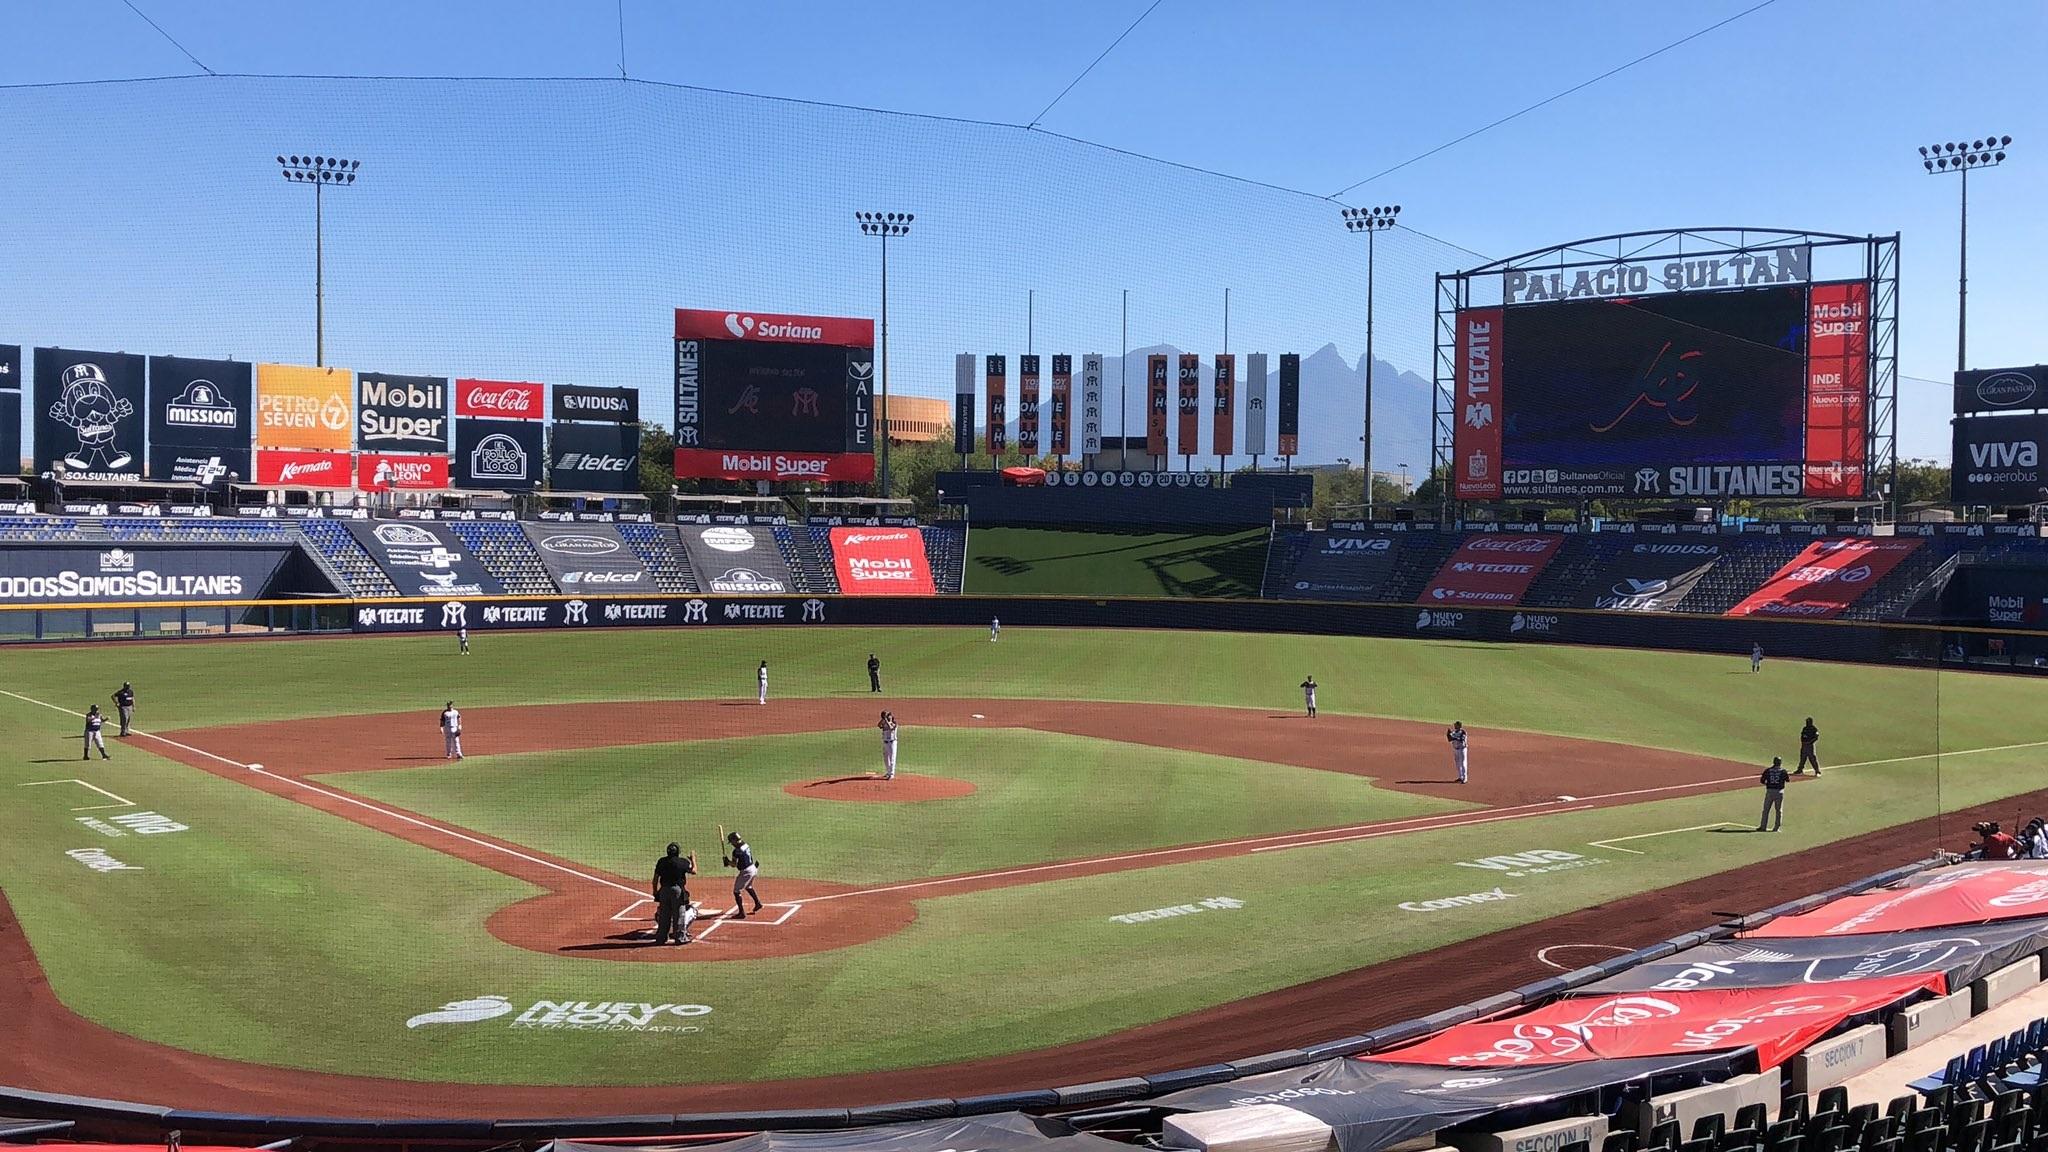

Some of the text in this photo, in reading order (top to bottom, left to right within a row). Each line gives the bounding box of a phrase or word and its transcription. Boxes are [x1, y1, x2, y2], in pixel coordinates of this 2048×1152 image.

[1504, 247, 1810, 304] PALACIO SULTAN
[1813, 303, 1862, 318] Mobil
[757, 322, 822, 339] Soriana
[1813, 321, 1862, 335] Super
[1467, 320, 1490, 399] TECATE
[678, 340, 698, 423] SULTANES
[1813, 373, 1841, 384] INDE
[362, 381, 441, 409] Mobil
[467, 387, 531, 410] Coca-Cola
[260, 394, 319, 413] PETRO
[577, 396, 629, 411] VIDUSA
[264, 411, 315, 428] SEVEN
[360, 409, 442, 440] Super
[494, 441, 505, 449] EL
[482, 449, 519, 461] POLLO
[577, 453, 636, 471] telcel
[208, 465, 223, 474] 24
[279, 460, 332, 482] Kermato
[394, 463, 431, 473] NUEVO
[483, 460, 518, 472] LOCO
[722, 455, 828, 477] Mobil Super
[1560, 472, 1626, 480] SultanesOficial
[1669, 465, 1800, 495] SULTANES
[1993, 469, 2038, 482] aerobus
[1503, 484, 1625, 494] www.sultanes.com.mx
[844, 533, 908, 545] Kermato
[1651, 545, 1719, 554] VIDUSA
[849, 558, 912, 569] Mobil
[1476, 563, 1535, 574] TECATE
[583, 571, 642, 582] telcel
[851, 568, 912, 580] Super
[1456, 590, 1514, 601] Soriana
[1989, 596, 2024, 608] Mobil
[1595, 597, 1661, 610] VALUE
[377, 608, 425, 624] TECATE
[502, 606, 548, 622] TECATE
[623, 605, 667, 619] TECATE
[742, 605, 786, 619] TECATE
[1433, 611, 1463, 620] NUEVO
[1989, 608, 2023, 622] Super
[1526, 615, 1558, 624] NUEVO
[1398, 887, 1523, 912] Comex
[527, 1000, 713, 1016] NUEVO
[1825, 1038, 1864, 1069] SECCION 7
